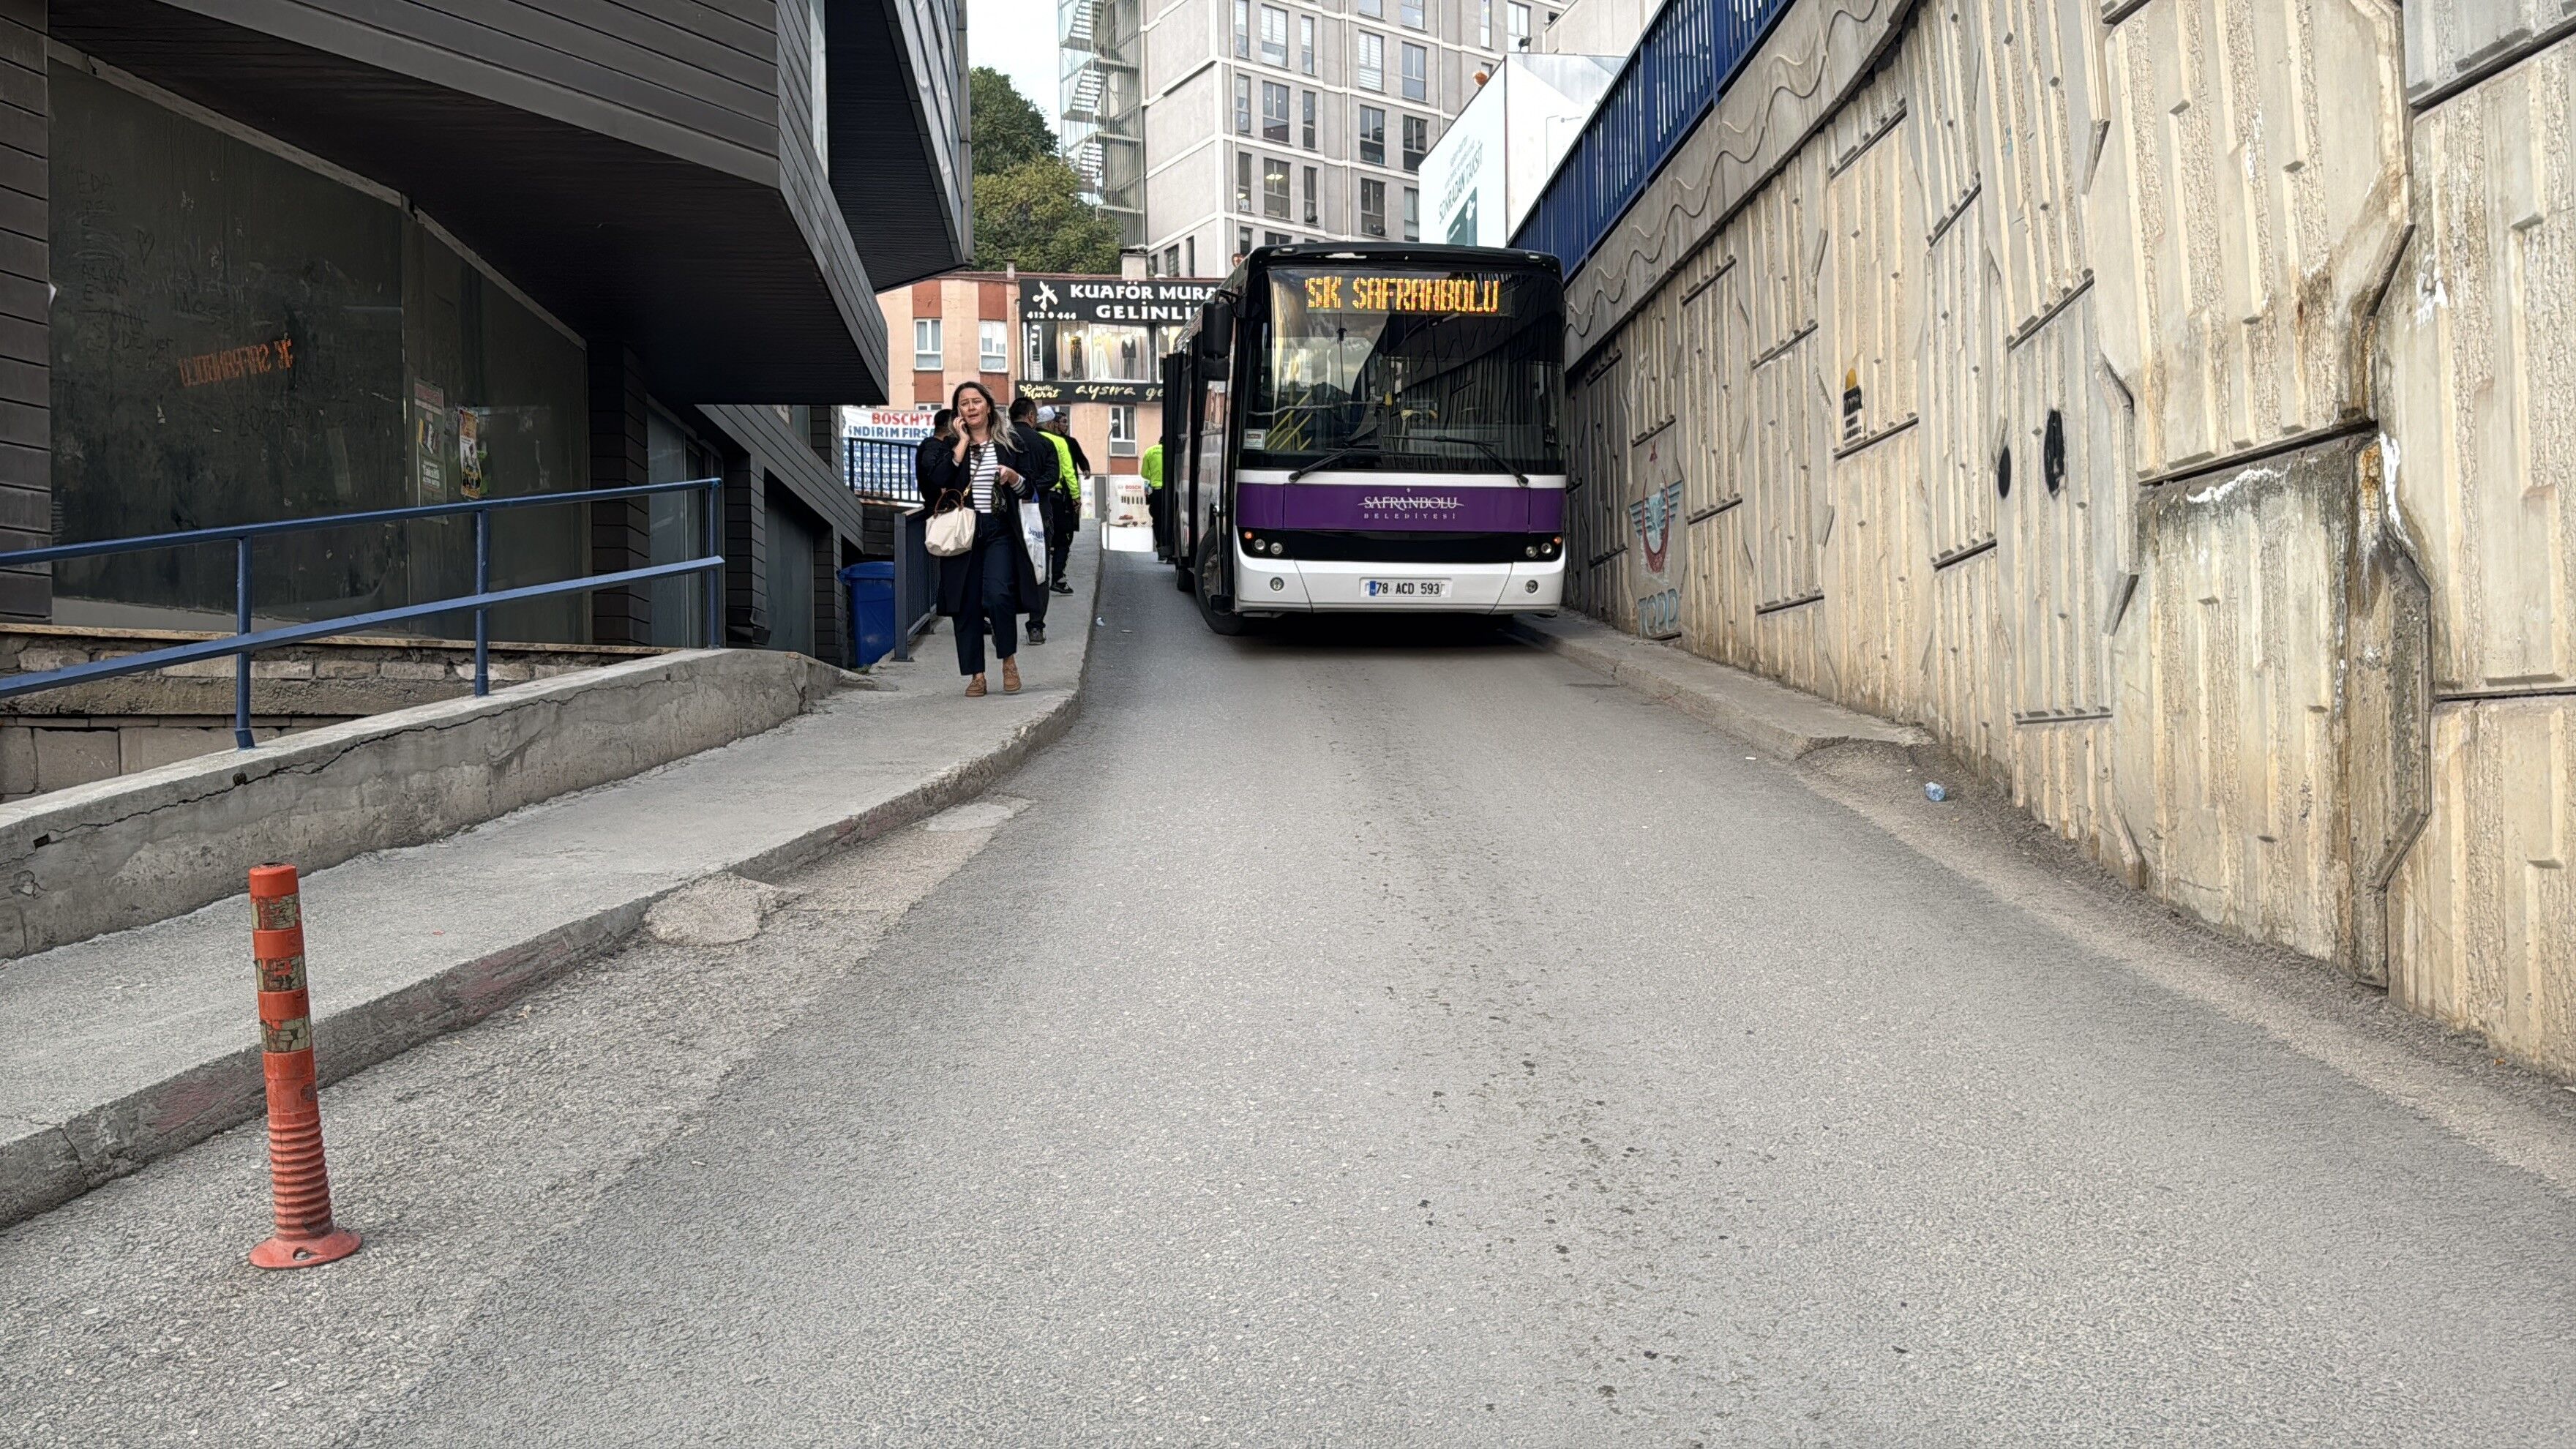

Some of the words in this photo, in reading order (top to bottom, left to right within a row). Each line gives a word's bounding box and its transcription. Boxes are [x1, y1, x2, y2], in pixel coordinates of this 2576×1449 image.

[1070, 281, 1154, 300] KUAFÖR
[1352, 277, 1500, 312] SAFRANBOLU
[1096, 302, 1199, 321] GELİNLİ
[872, 412, 935, 426] BOSCH'T
[1363, 496, 1459, 511] SAFRANBOLU
[1377, 583, 1388, 594] 78
[1396, 583, 1415, 594] ACD
[1420, 583, 1439, 594] 593
